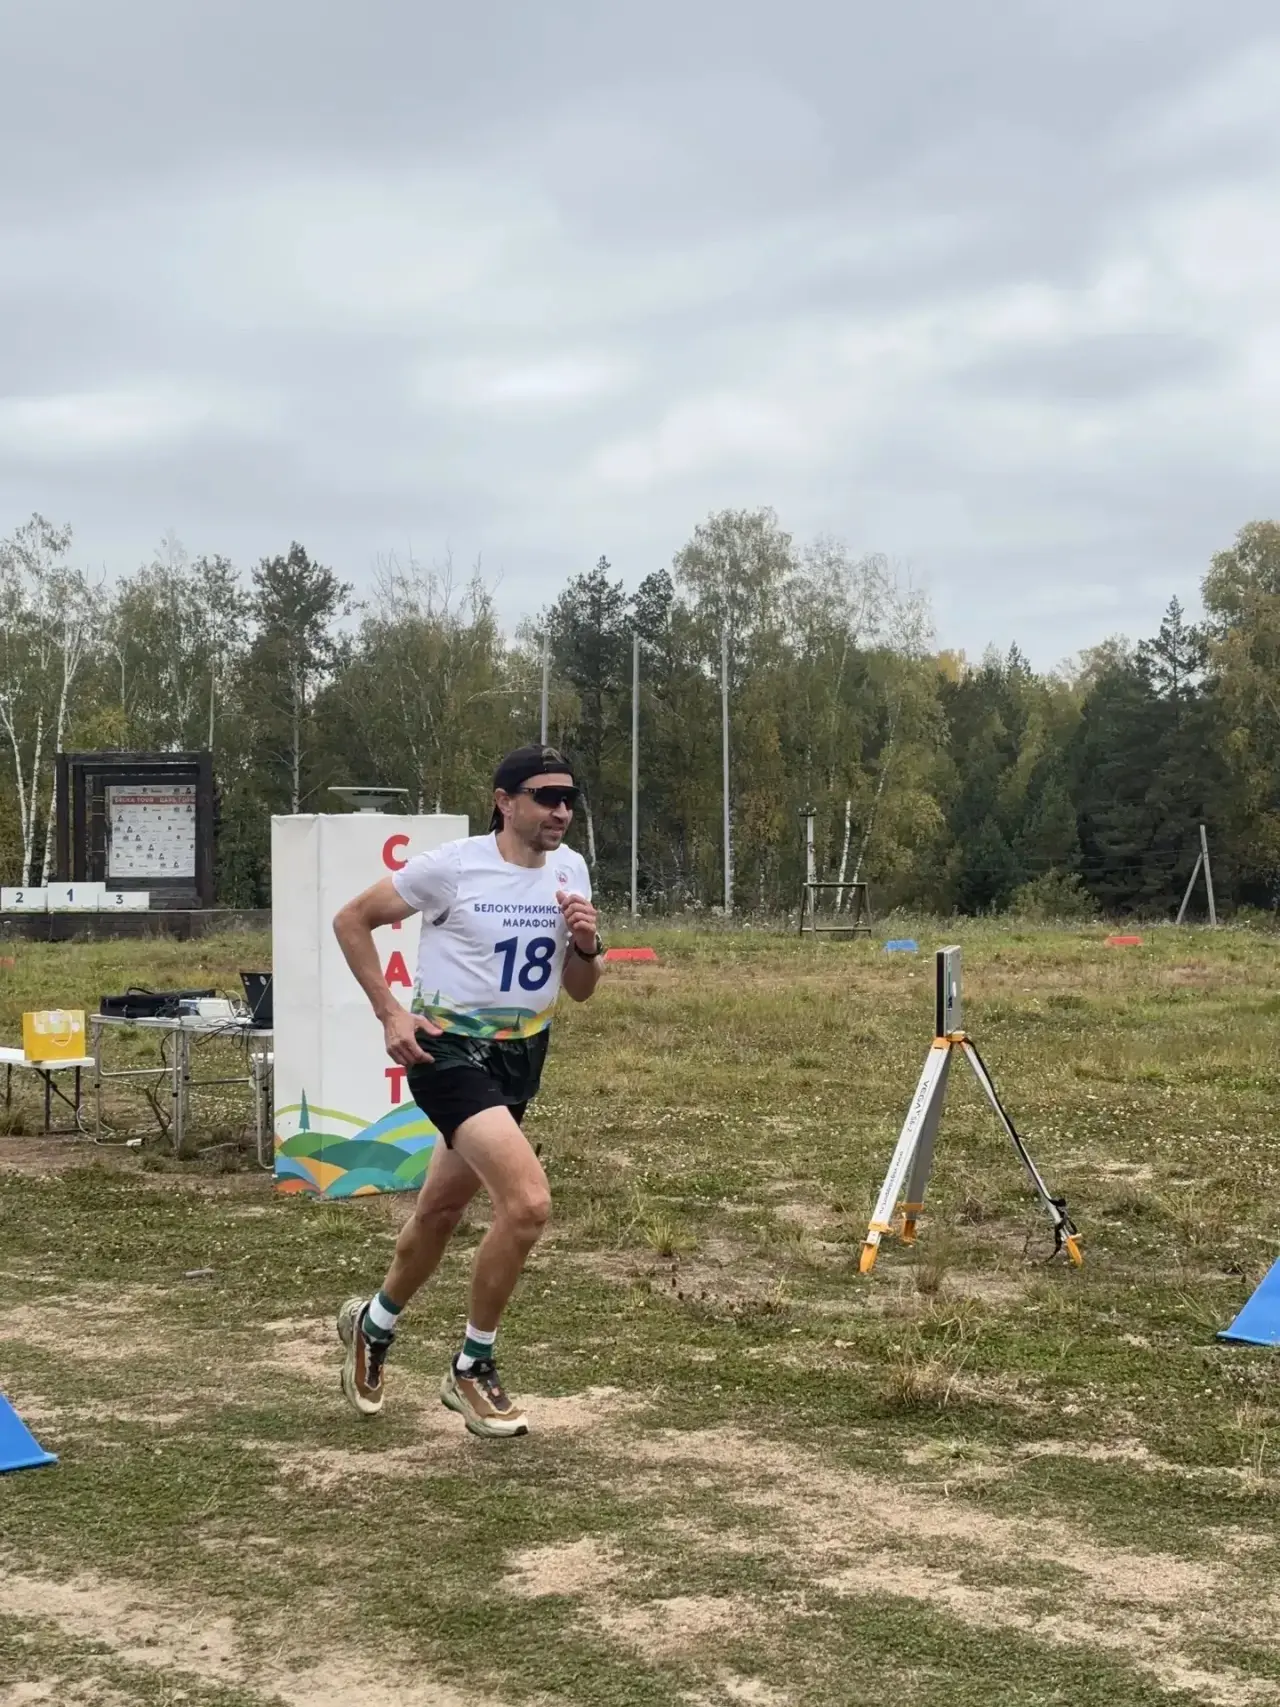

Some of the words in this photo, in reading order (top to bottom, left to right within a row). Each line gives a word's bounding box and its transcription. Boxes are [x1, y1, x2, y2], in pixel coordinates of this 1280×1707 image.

[15, 892, 24, 903] 2
[66, 888, 74, 902] 1
[115, 894, 124, 905] 3
[502, 918, 556, 929] МАРАФОН
[494, 936, 556, 992] 18
